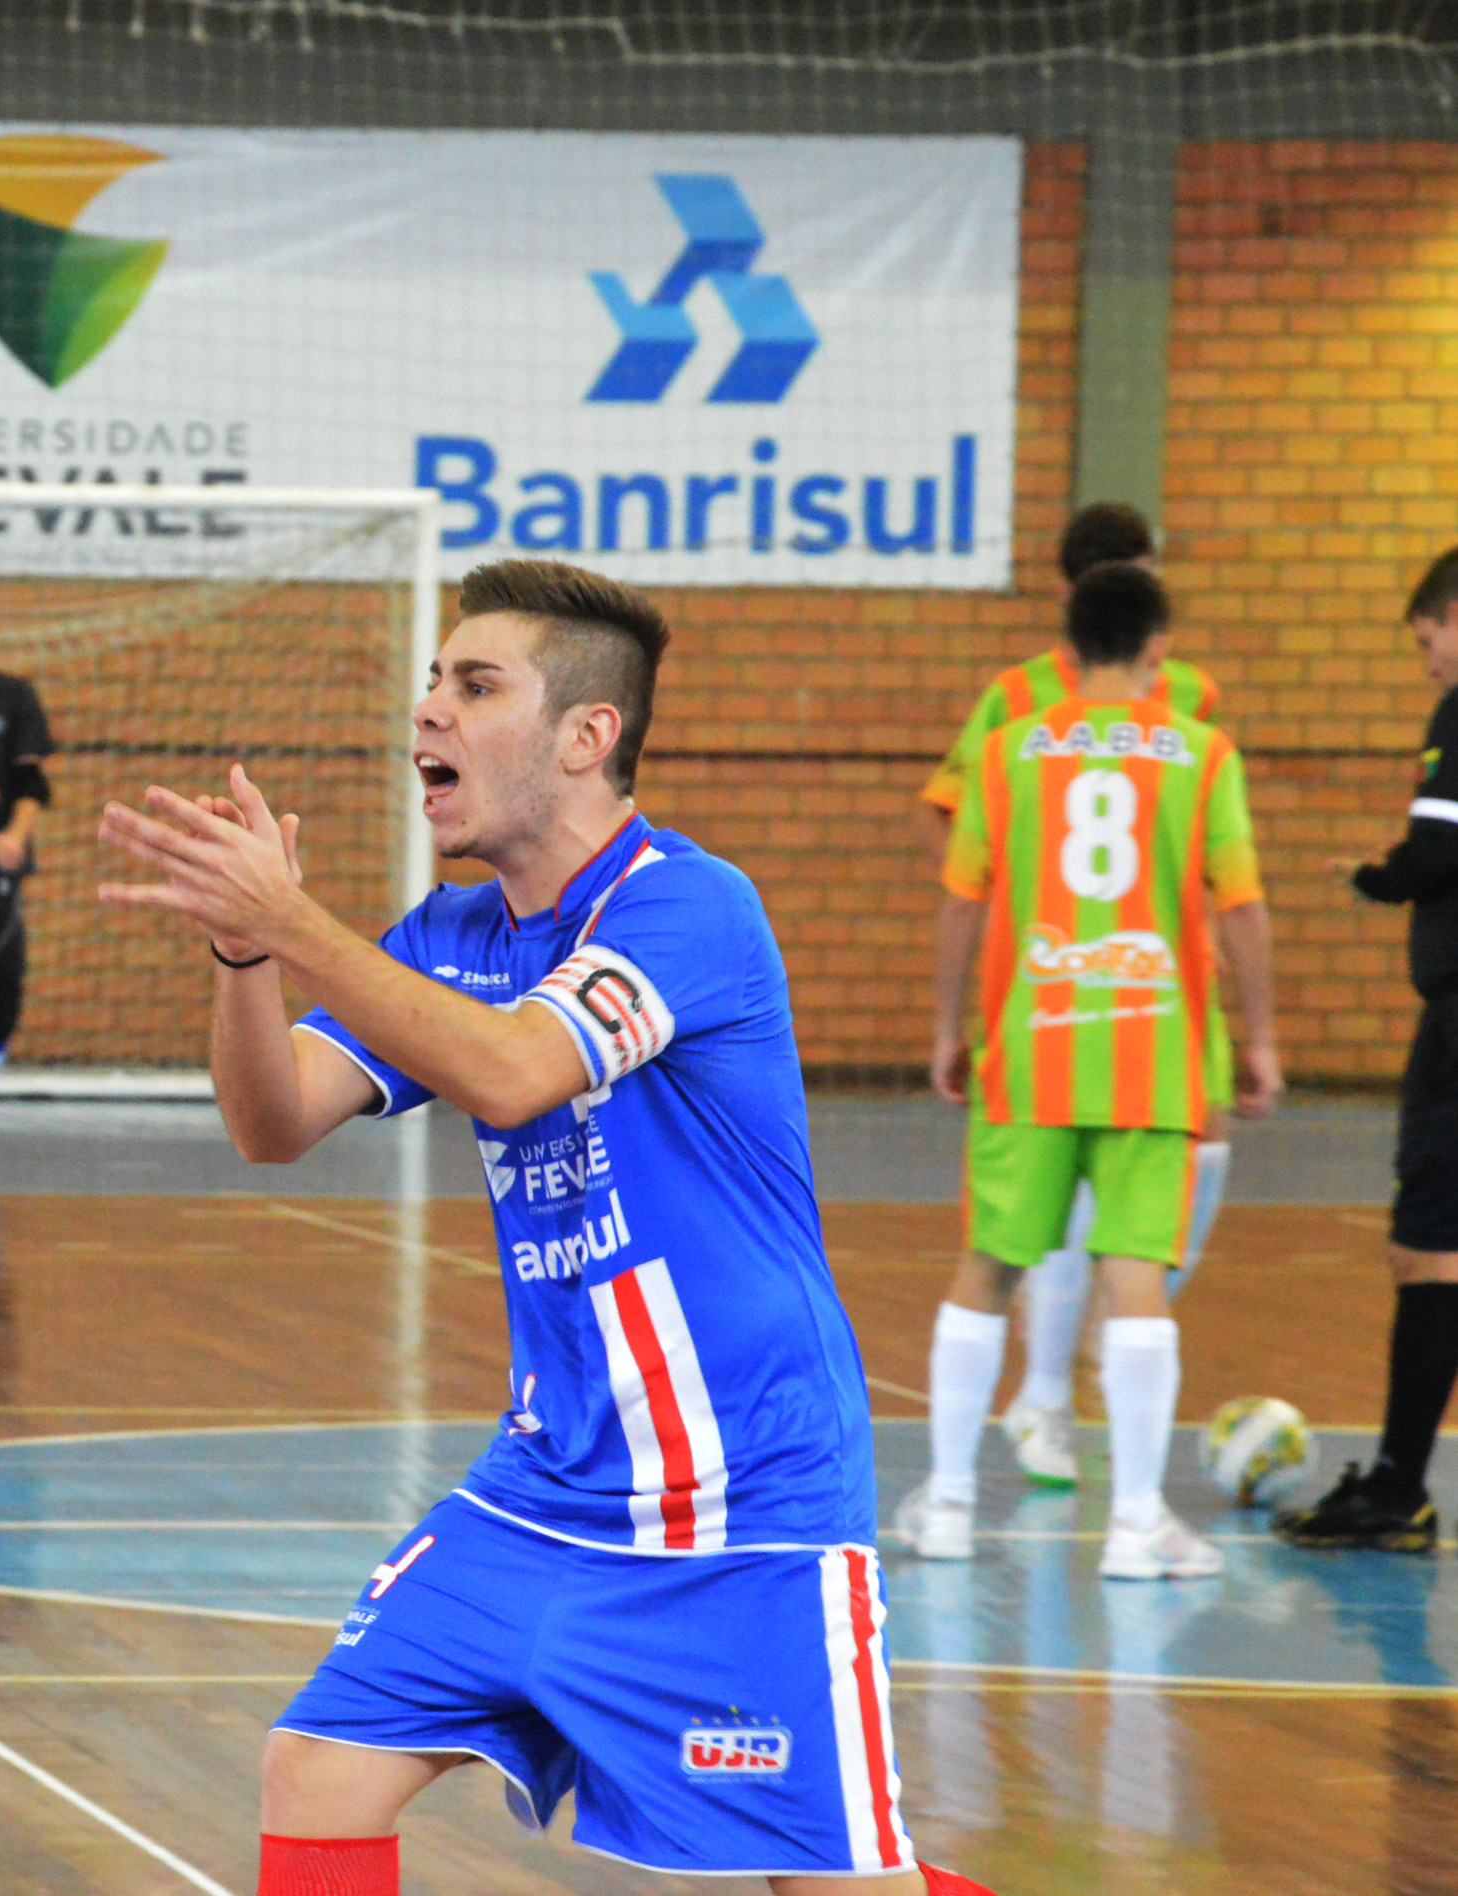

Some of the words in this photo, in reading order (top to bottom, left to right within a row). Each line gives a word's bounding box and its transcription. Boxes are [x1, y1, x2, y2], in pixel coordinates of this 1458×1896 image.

[415, 432, 976, 555] Banrisul
[1060, 769, 1140, 902] 8
[577, 968, 640, 1034] C
[690, 1735, 779, 1768] UJR
